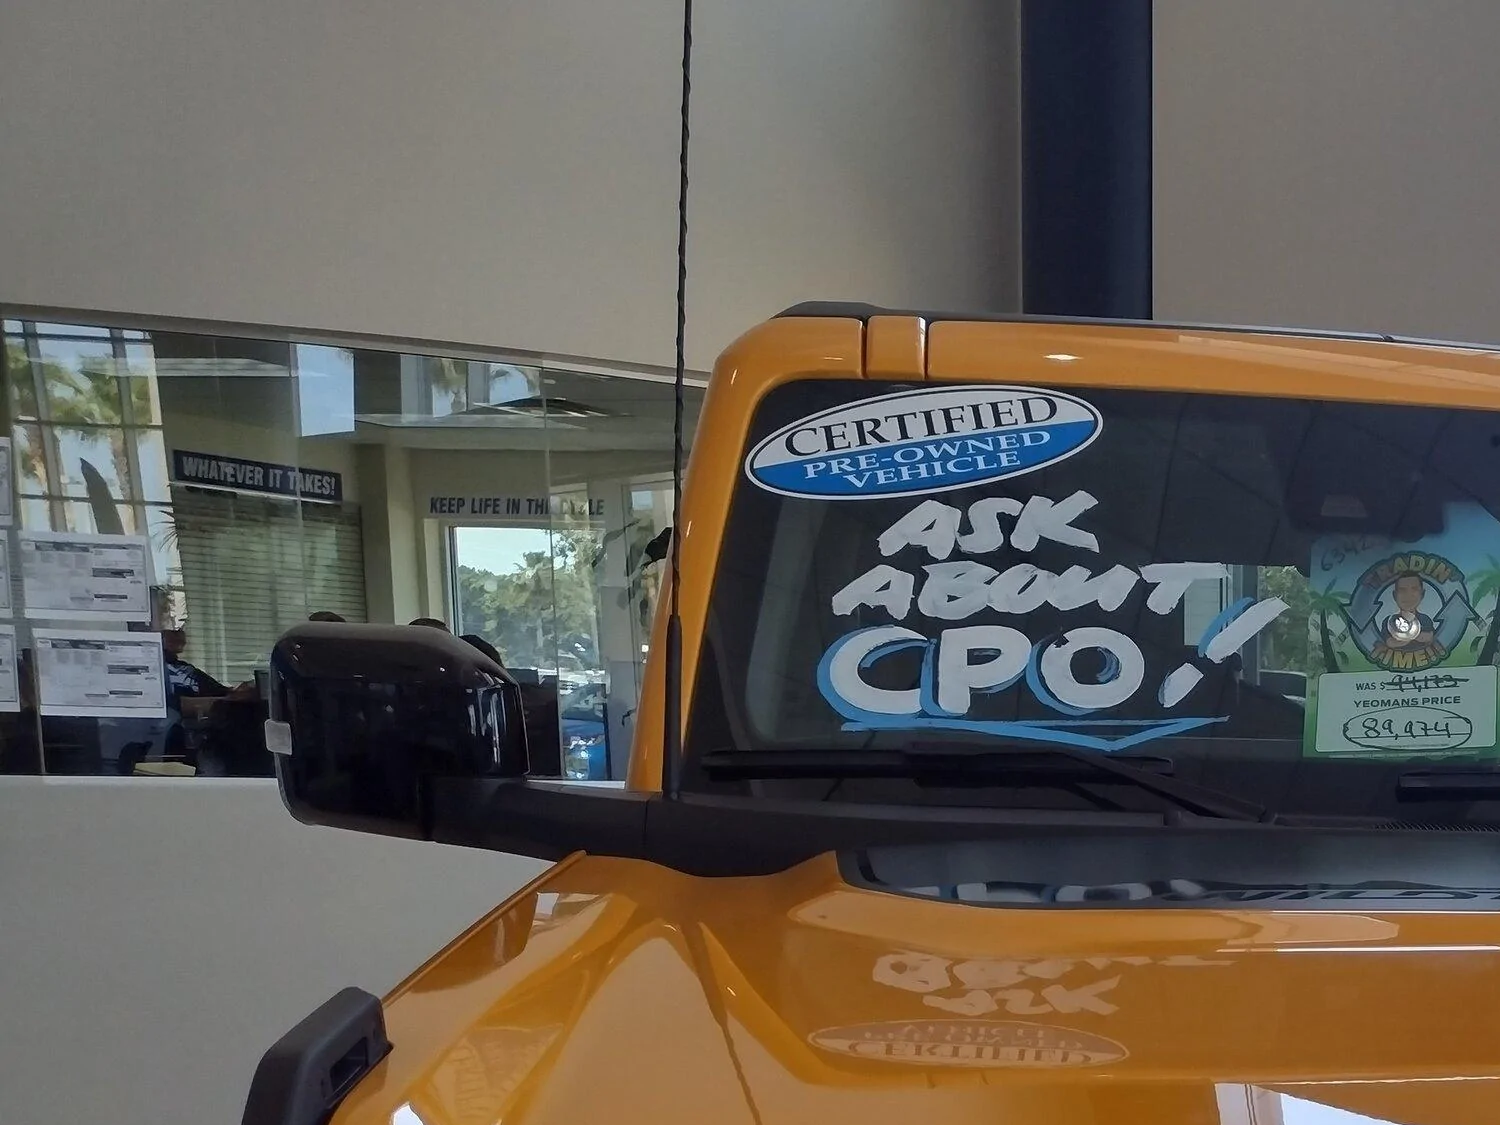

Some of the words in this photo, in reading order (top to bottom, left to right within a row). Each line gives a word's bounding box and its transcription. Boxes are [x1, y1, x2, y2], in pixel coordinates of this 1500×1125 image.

[785, 396, 1058, 457] CERTIFIED
[182, 455, 264, 488] WHATEVER
[268, 468, 284, 488] IT
[287, 470, 336, 496] TAKES!
[803, 430, 1050, 479] PRE-OWNED
[842, 451, 1021, 488] VEHICLE
[429, 496, 466, 515] KEEP
[470, 497, 500, 515] LIFE
[506, 497, 521, 515] IN
[876, 490, 1100, 561] ASK
[831, 560, 1232, 620] ABOUT
[817, 596, 1291, 721] CPO!
[1353, 697, 1419, 708] YEOMANS
[1422, 695, 1461, 704] PRICE
[1355, 682, 1376, 691] WAS
